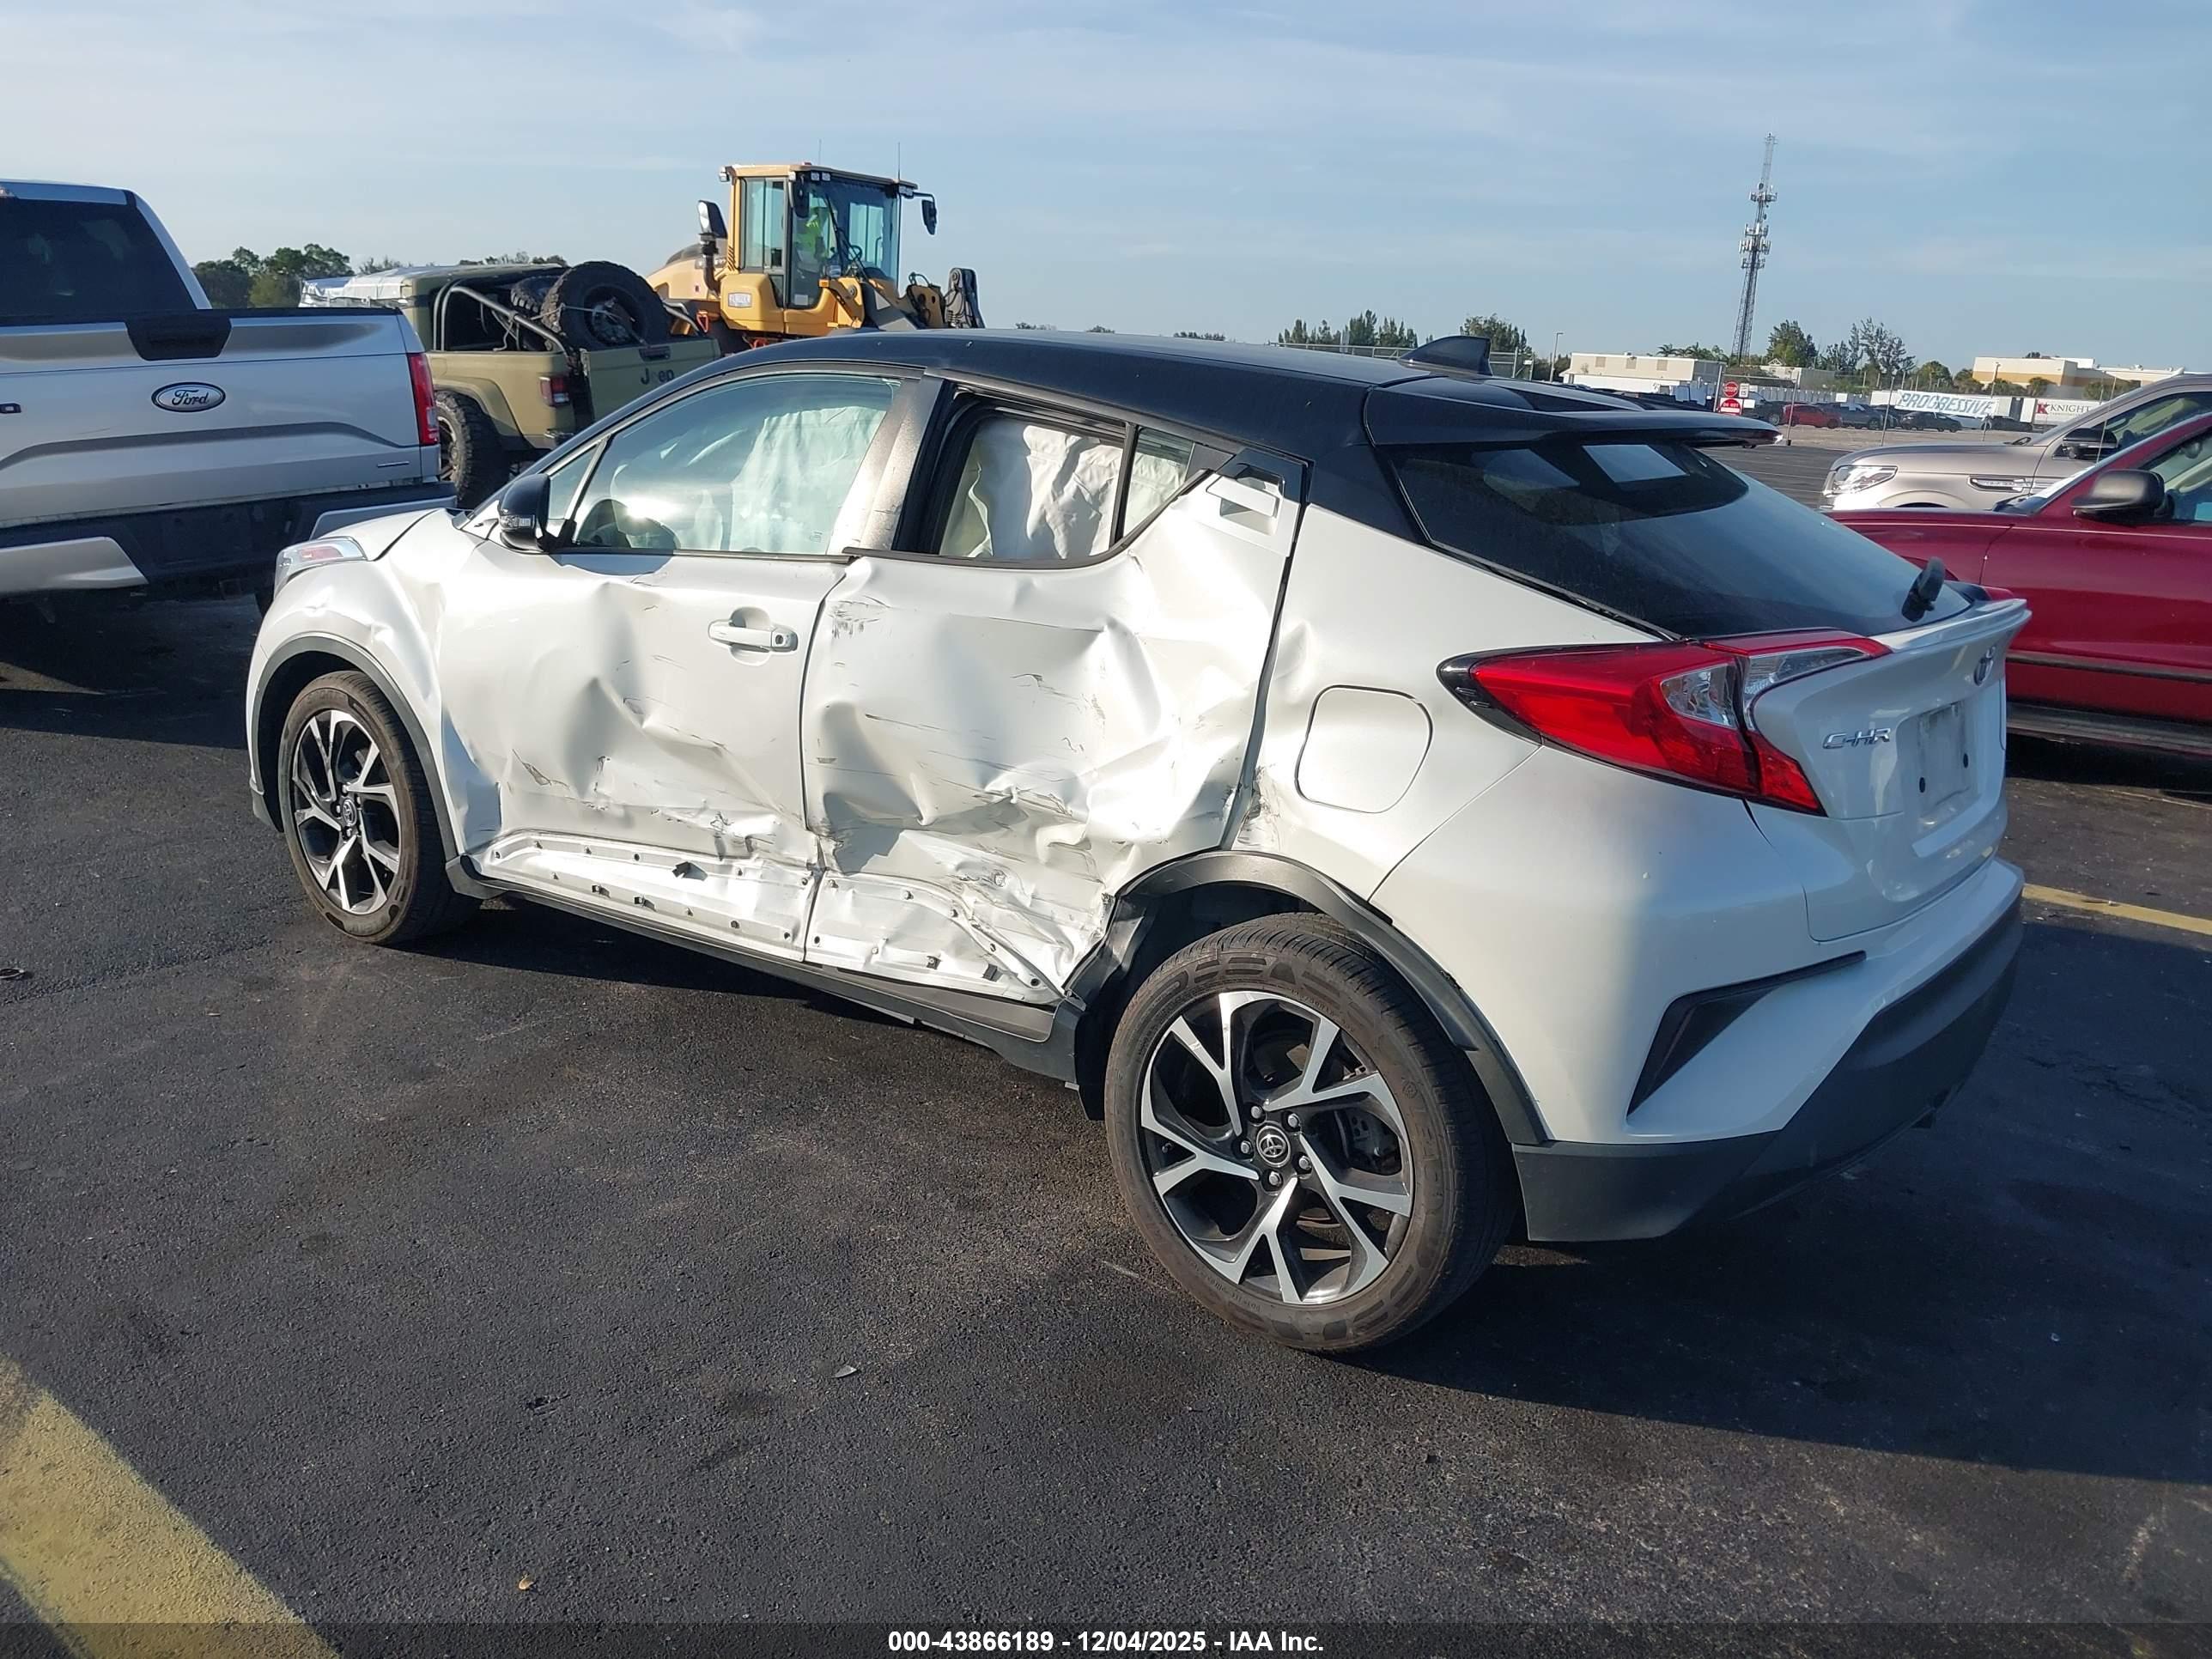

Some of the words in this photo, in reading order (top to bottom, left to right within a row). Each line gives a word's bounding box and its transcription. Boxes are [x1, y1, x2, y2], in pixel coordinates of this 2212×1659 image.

[172, 389, 209, 405] Ford
[1898, 392, 1994, 415] PROGRESSIVE
[1822, 728, 1891, 750] C-HR
